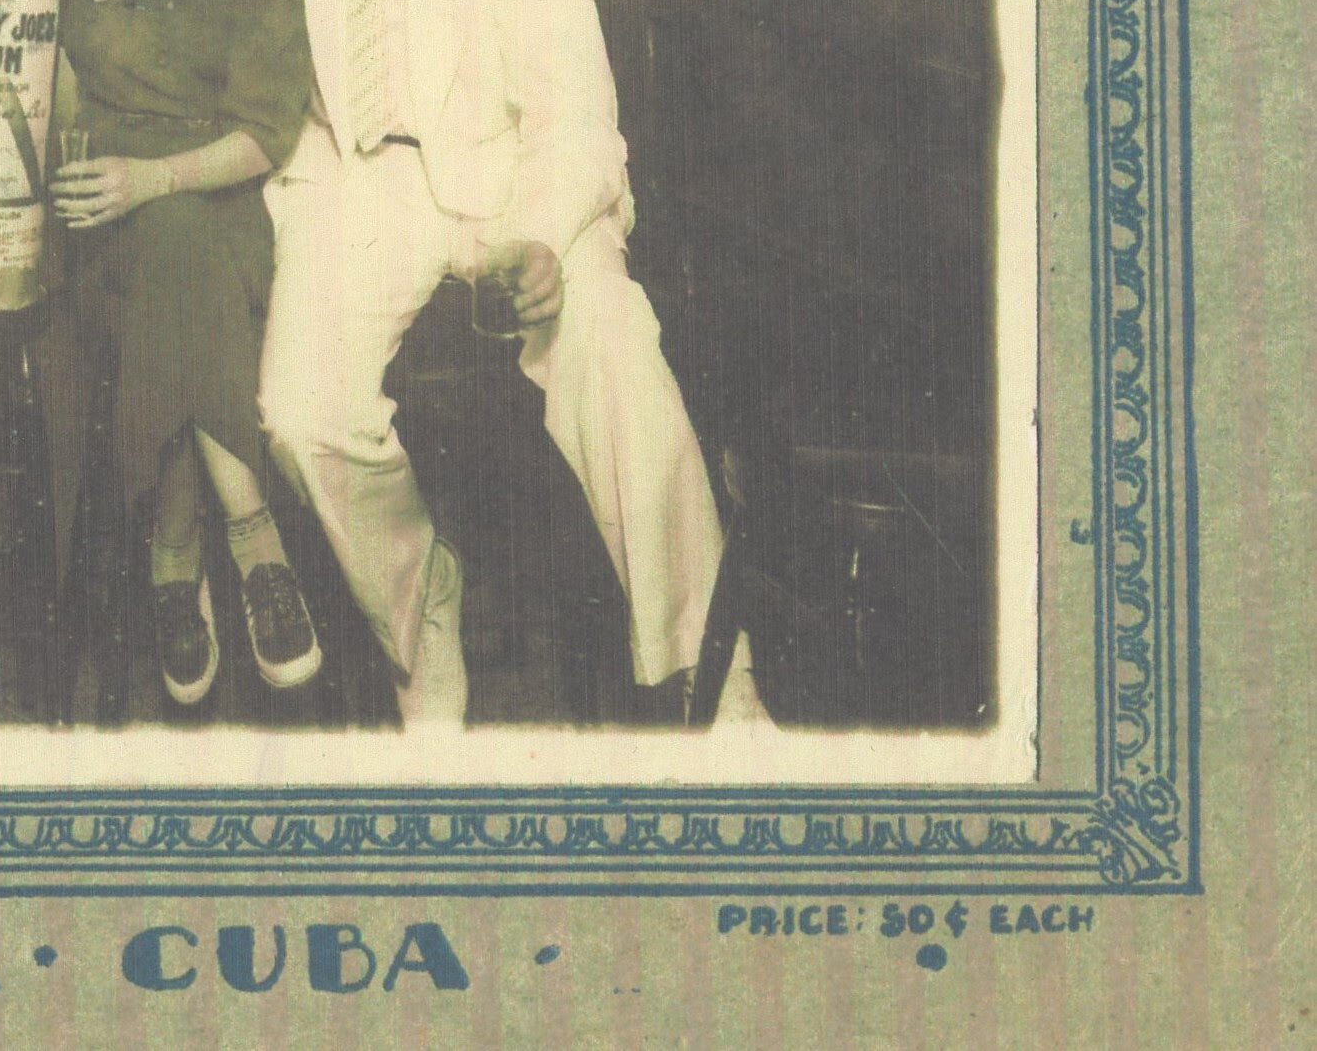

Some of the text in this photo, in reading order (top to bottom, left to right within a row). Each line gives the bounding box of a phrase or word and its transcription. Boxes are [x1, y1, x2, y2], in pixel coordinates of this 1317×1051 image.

[717, 904, 865, 936] PRICE:
[989, 904, 1094, 934] EACH
[121, 923, 469, 993] CUBA
